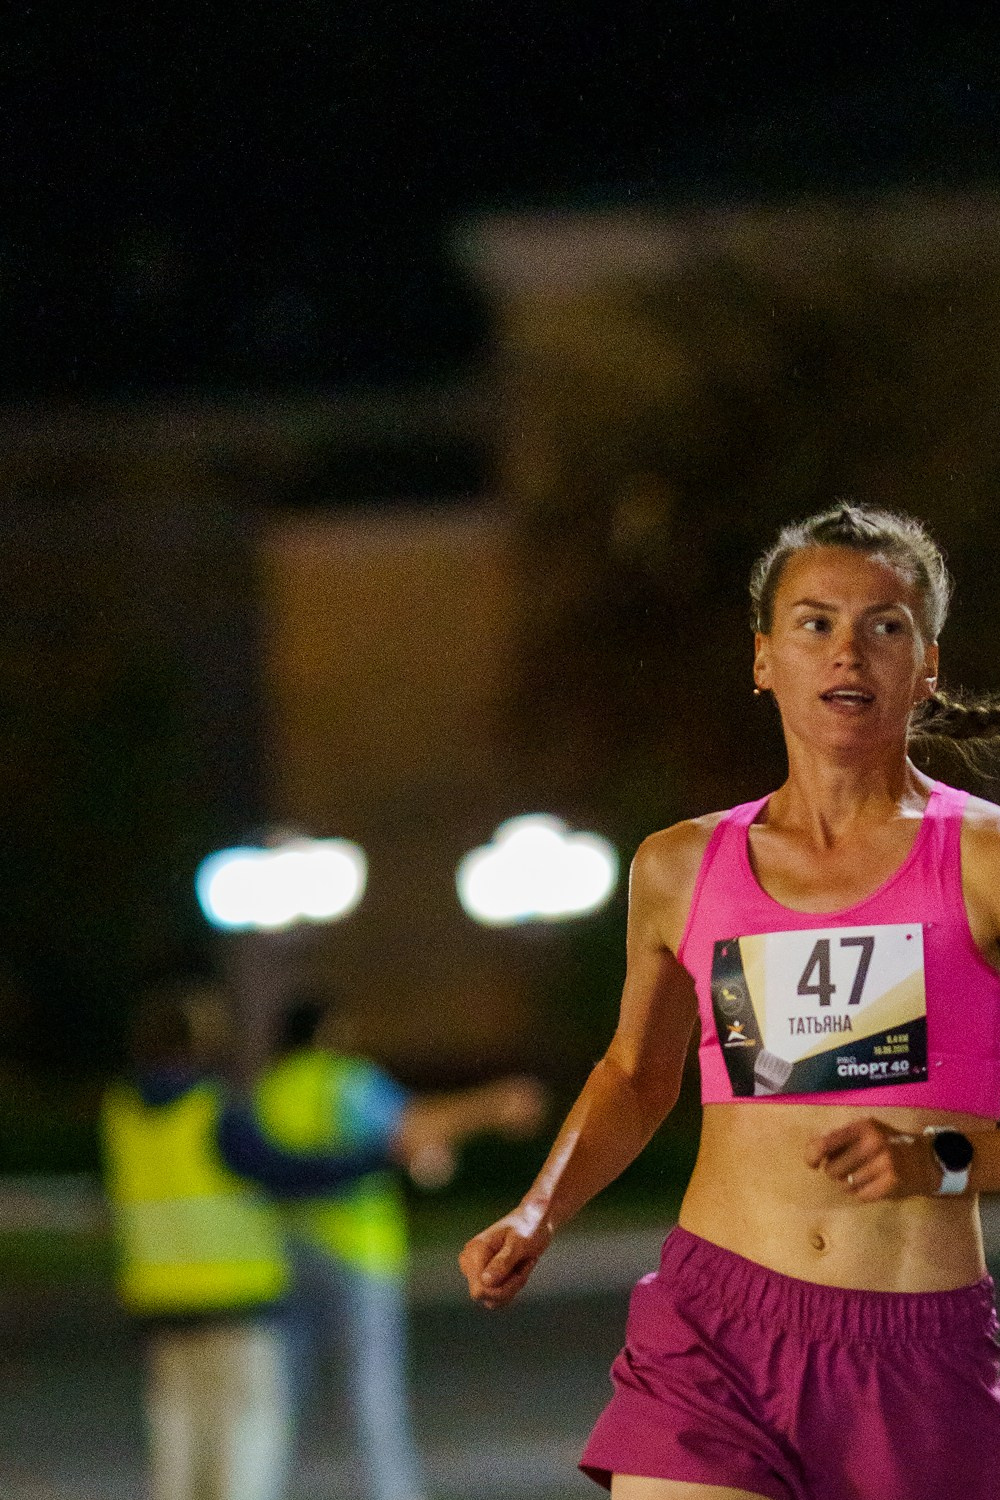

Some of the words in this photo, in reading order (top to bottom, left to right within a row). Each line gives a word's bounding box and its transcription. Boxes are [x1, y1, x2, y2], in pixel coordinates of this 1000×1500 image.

[797, 936, 875, 1006] 47
[788, 1014, 853, 1035] ТАТЬЯНА
[890, 1060, 910, 1072] 40
